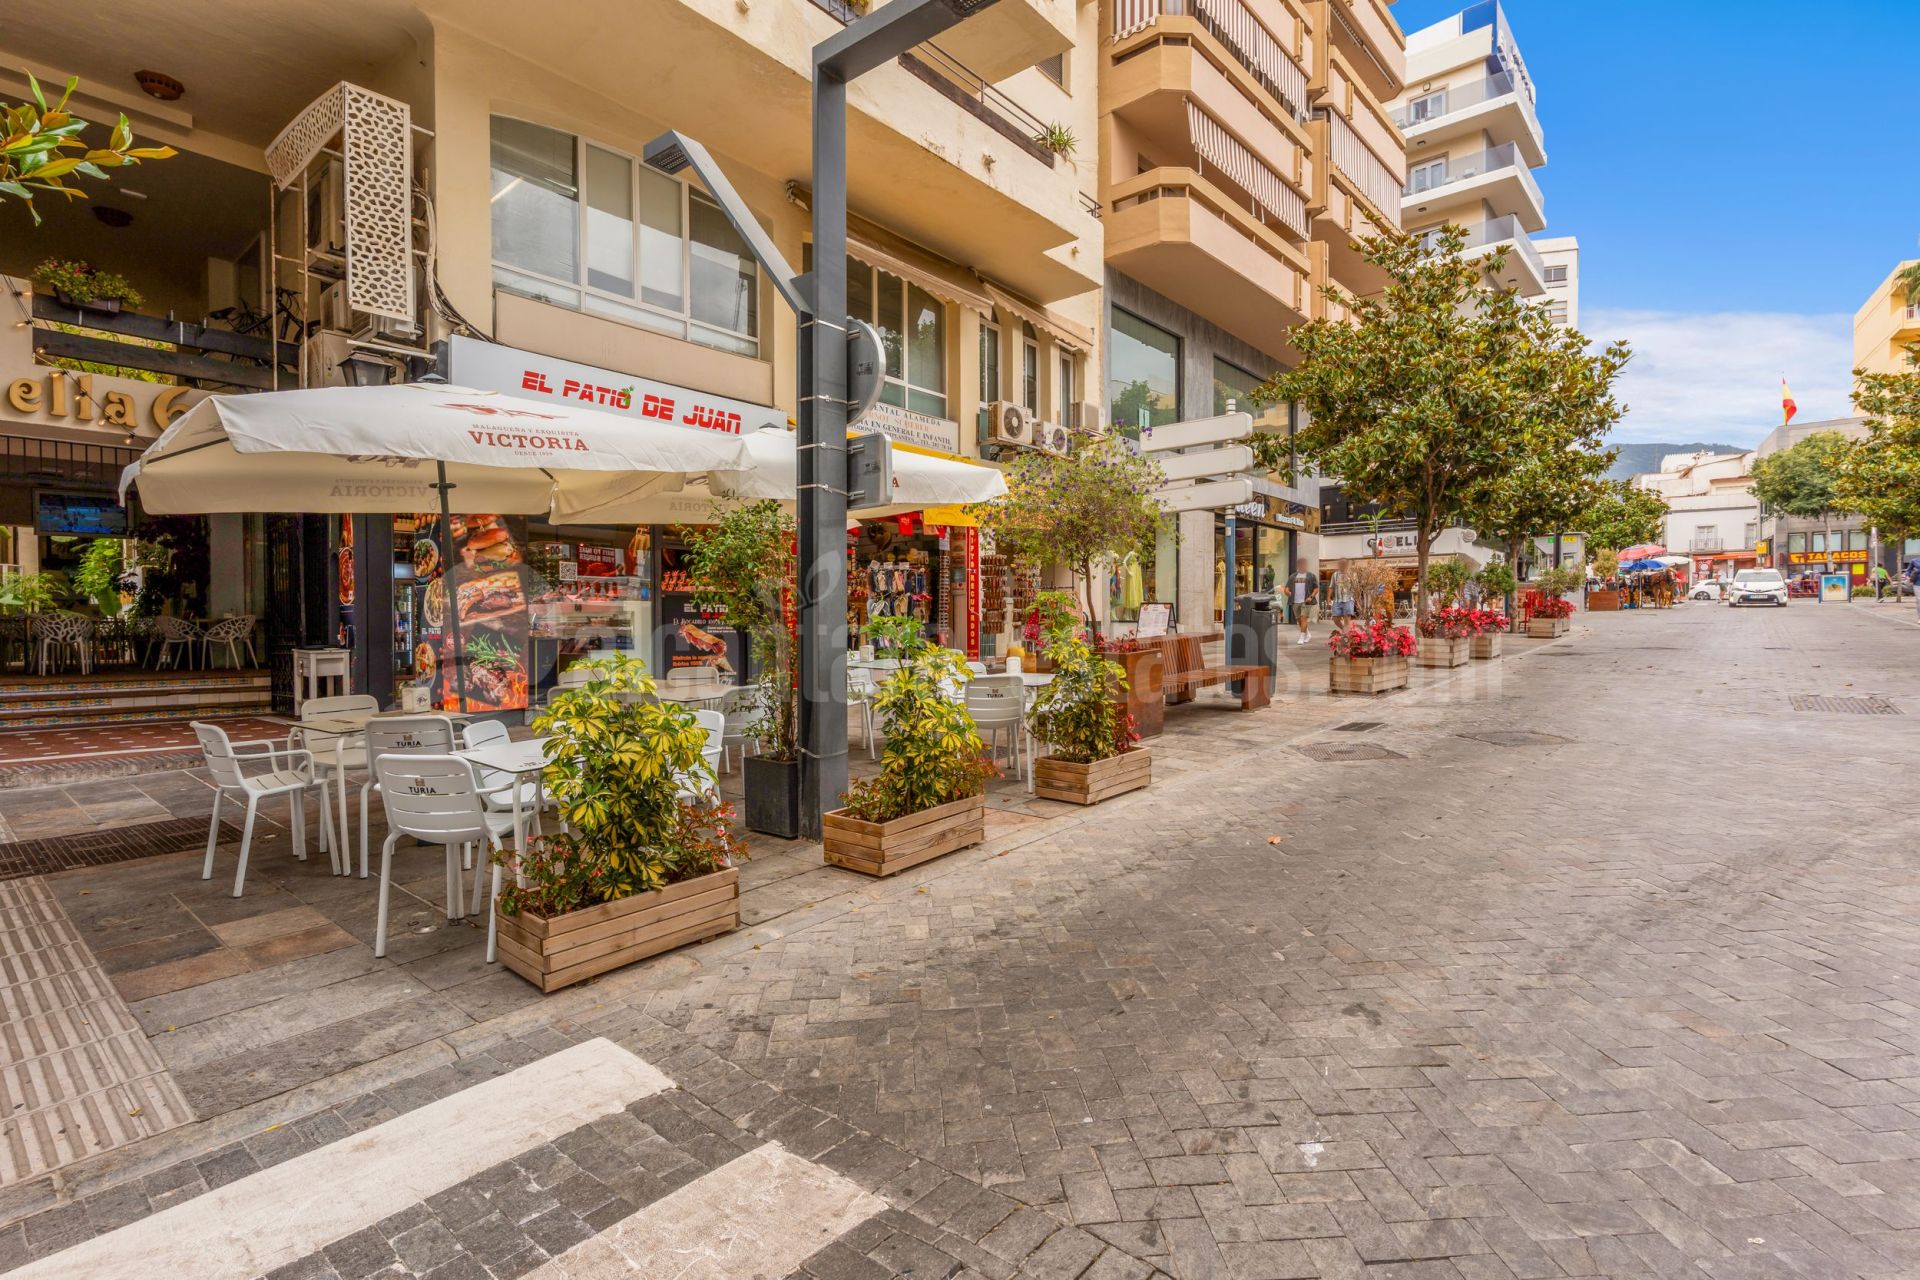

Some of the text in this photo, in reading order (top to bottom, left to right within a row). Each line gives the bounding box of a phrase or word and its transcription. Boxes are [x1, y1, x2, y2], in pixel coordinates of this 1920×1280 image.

[521, 370, 742, 435] EL PATIO DE JUAN
[904, 412, 941, 426] ALAMEDA
[467, 430, 590, 452] VICTORIA
[882, 423, 915, 436] GENERAL
[922, 432, 952, 446] INFANTIL
[1808, 551, 1867, 560] TAACOS
[684, 604, 697, 612] EL
